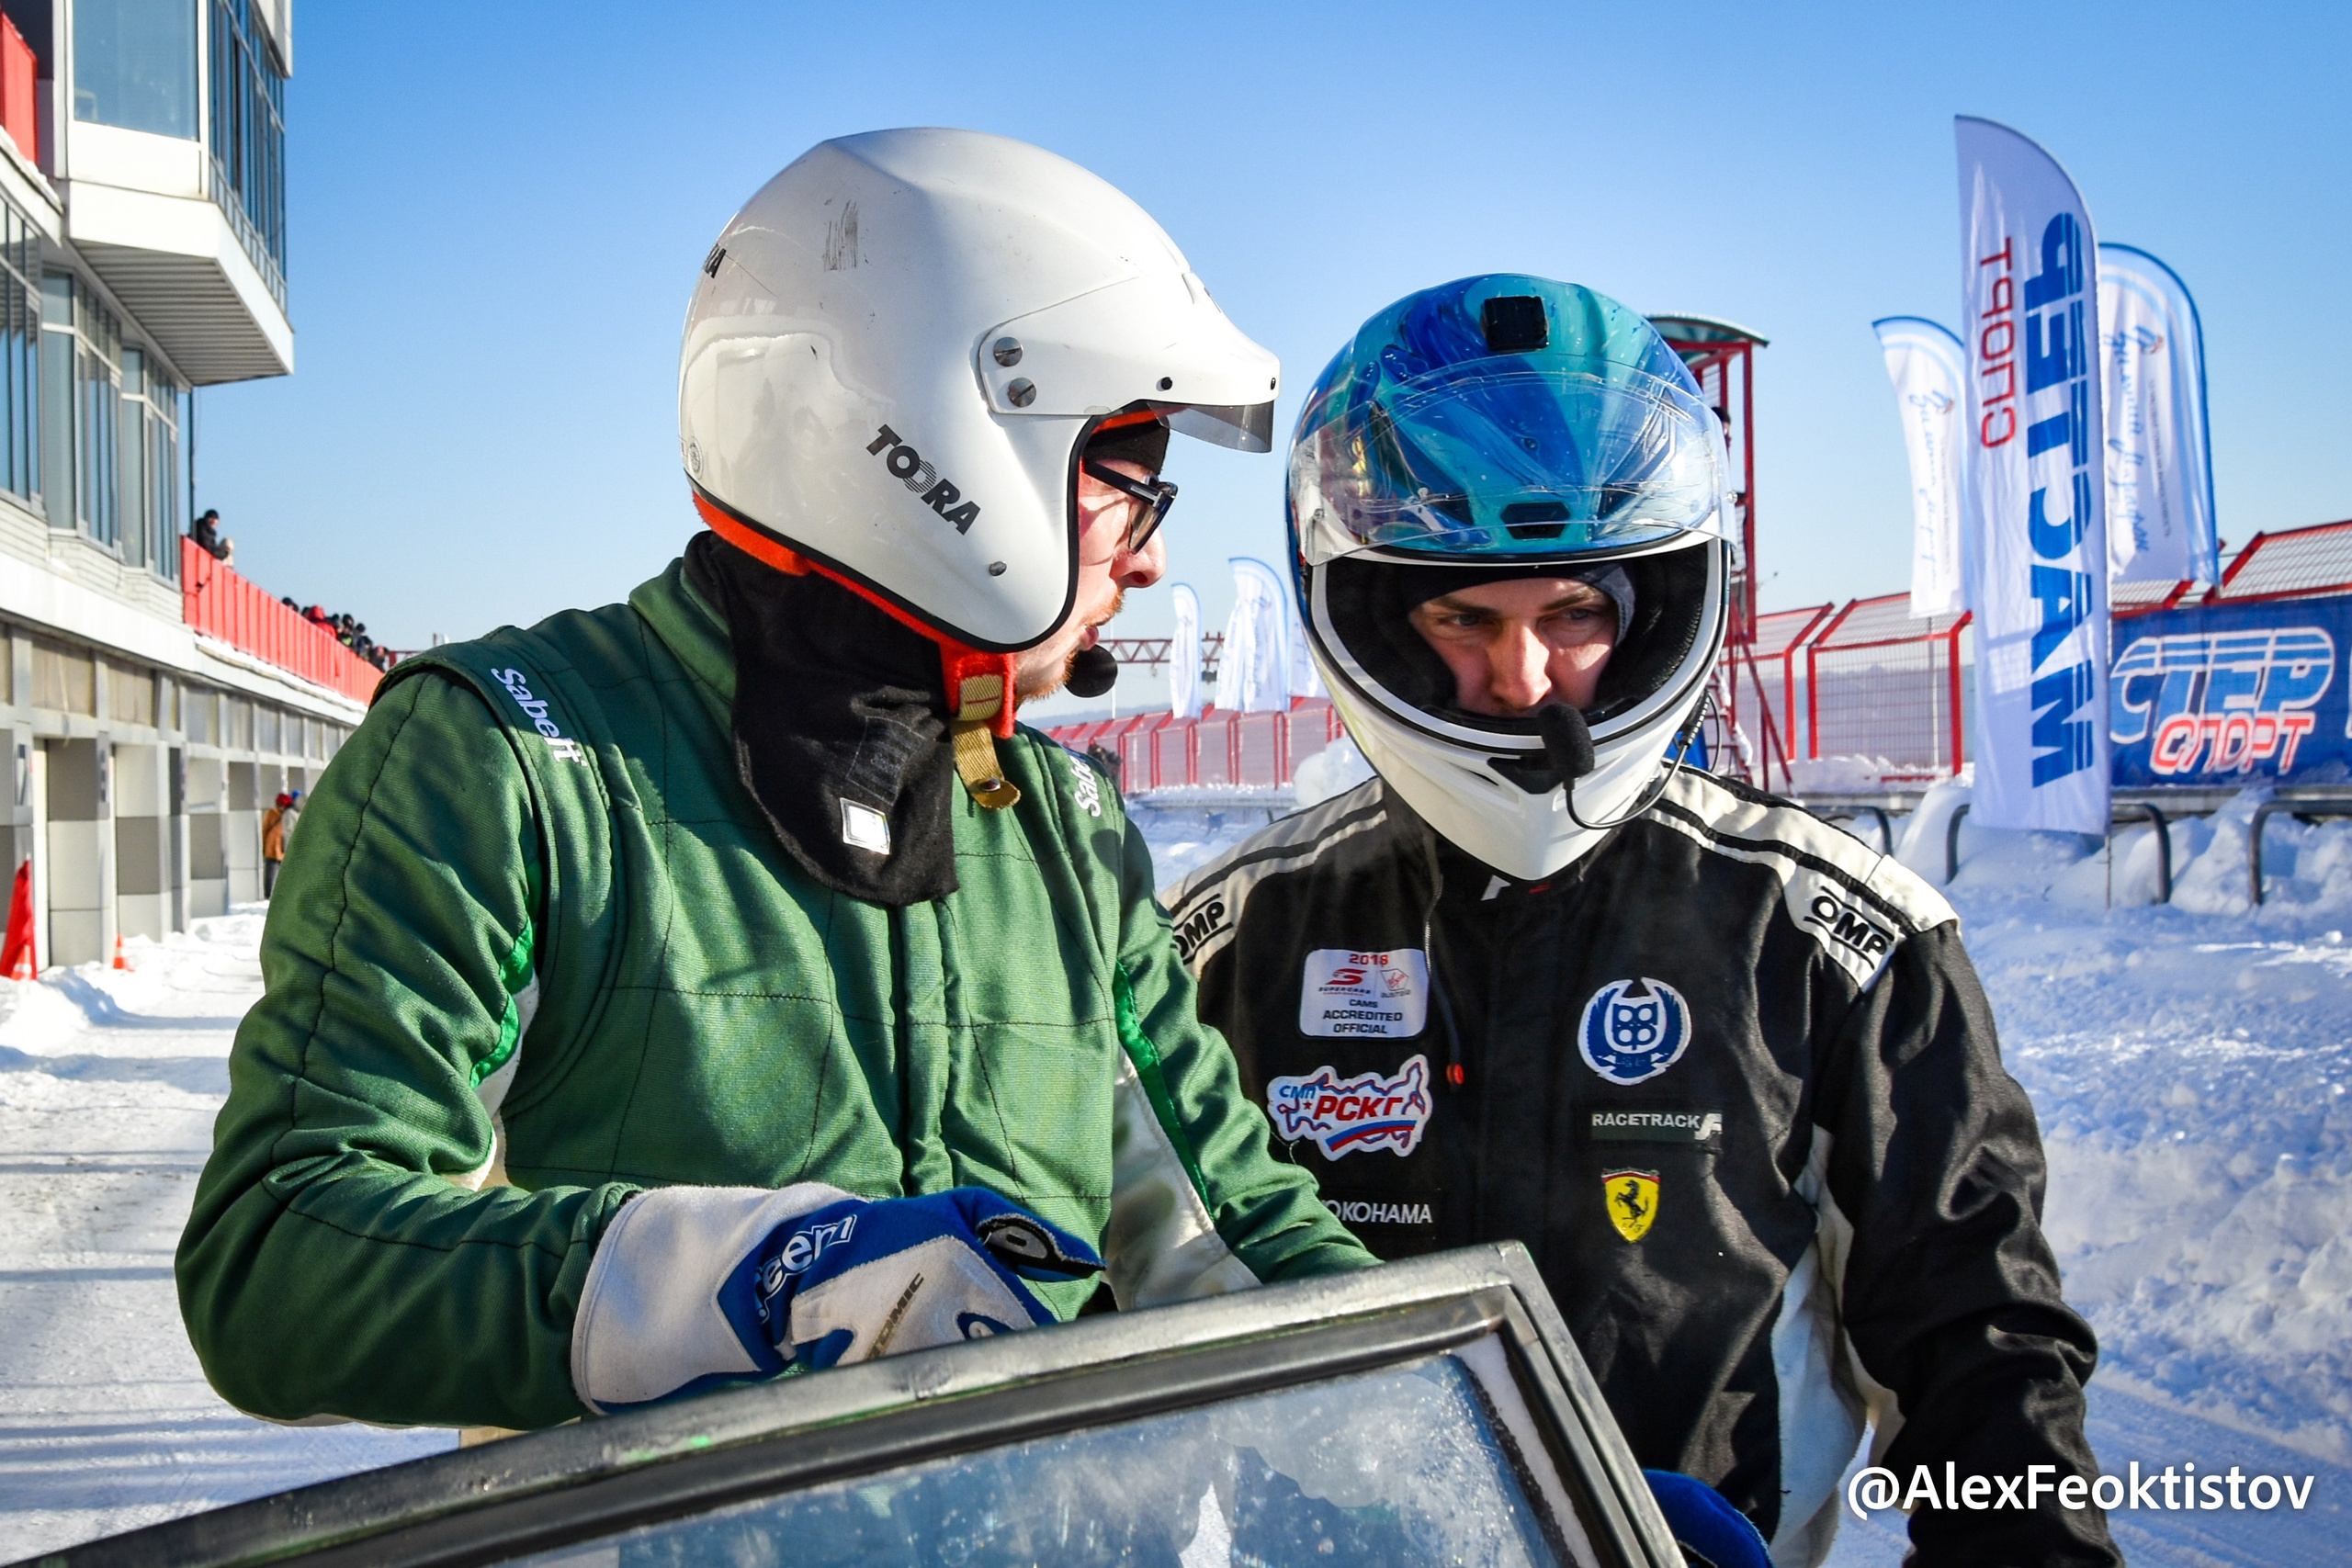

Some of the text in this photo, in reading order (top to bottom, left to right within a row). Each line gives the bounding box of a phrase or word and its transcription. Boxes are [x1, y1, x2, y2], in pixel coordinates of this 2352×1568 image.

[865, 423, 981, 536] TOORA
[2109, 626, 2335, 744] СТЕР
[491, 668, 582, 762] Sabelt
[2150, 712, 2315, 775] СПОРТ
[1069, 755, 1102, 818] Sabe
[1811, 896, 1887, 955] OMP
[1349, 953, 1388, 965] 2018
[1322, 1010, 1403, 1021] ACCREDITED
[1349, 998, 1378, 1009] CAMS
[1333, 1023, 1388, 1034] OFFICIAL
[1279, 1085, 1317, 1100] СМП
[1591, 1113, 1701, 1129] RACETRACK
[1321, 1200, 1433, 1224] OKOHAMA
[866, 1272, 924, 1359] TOMIC
